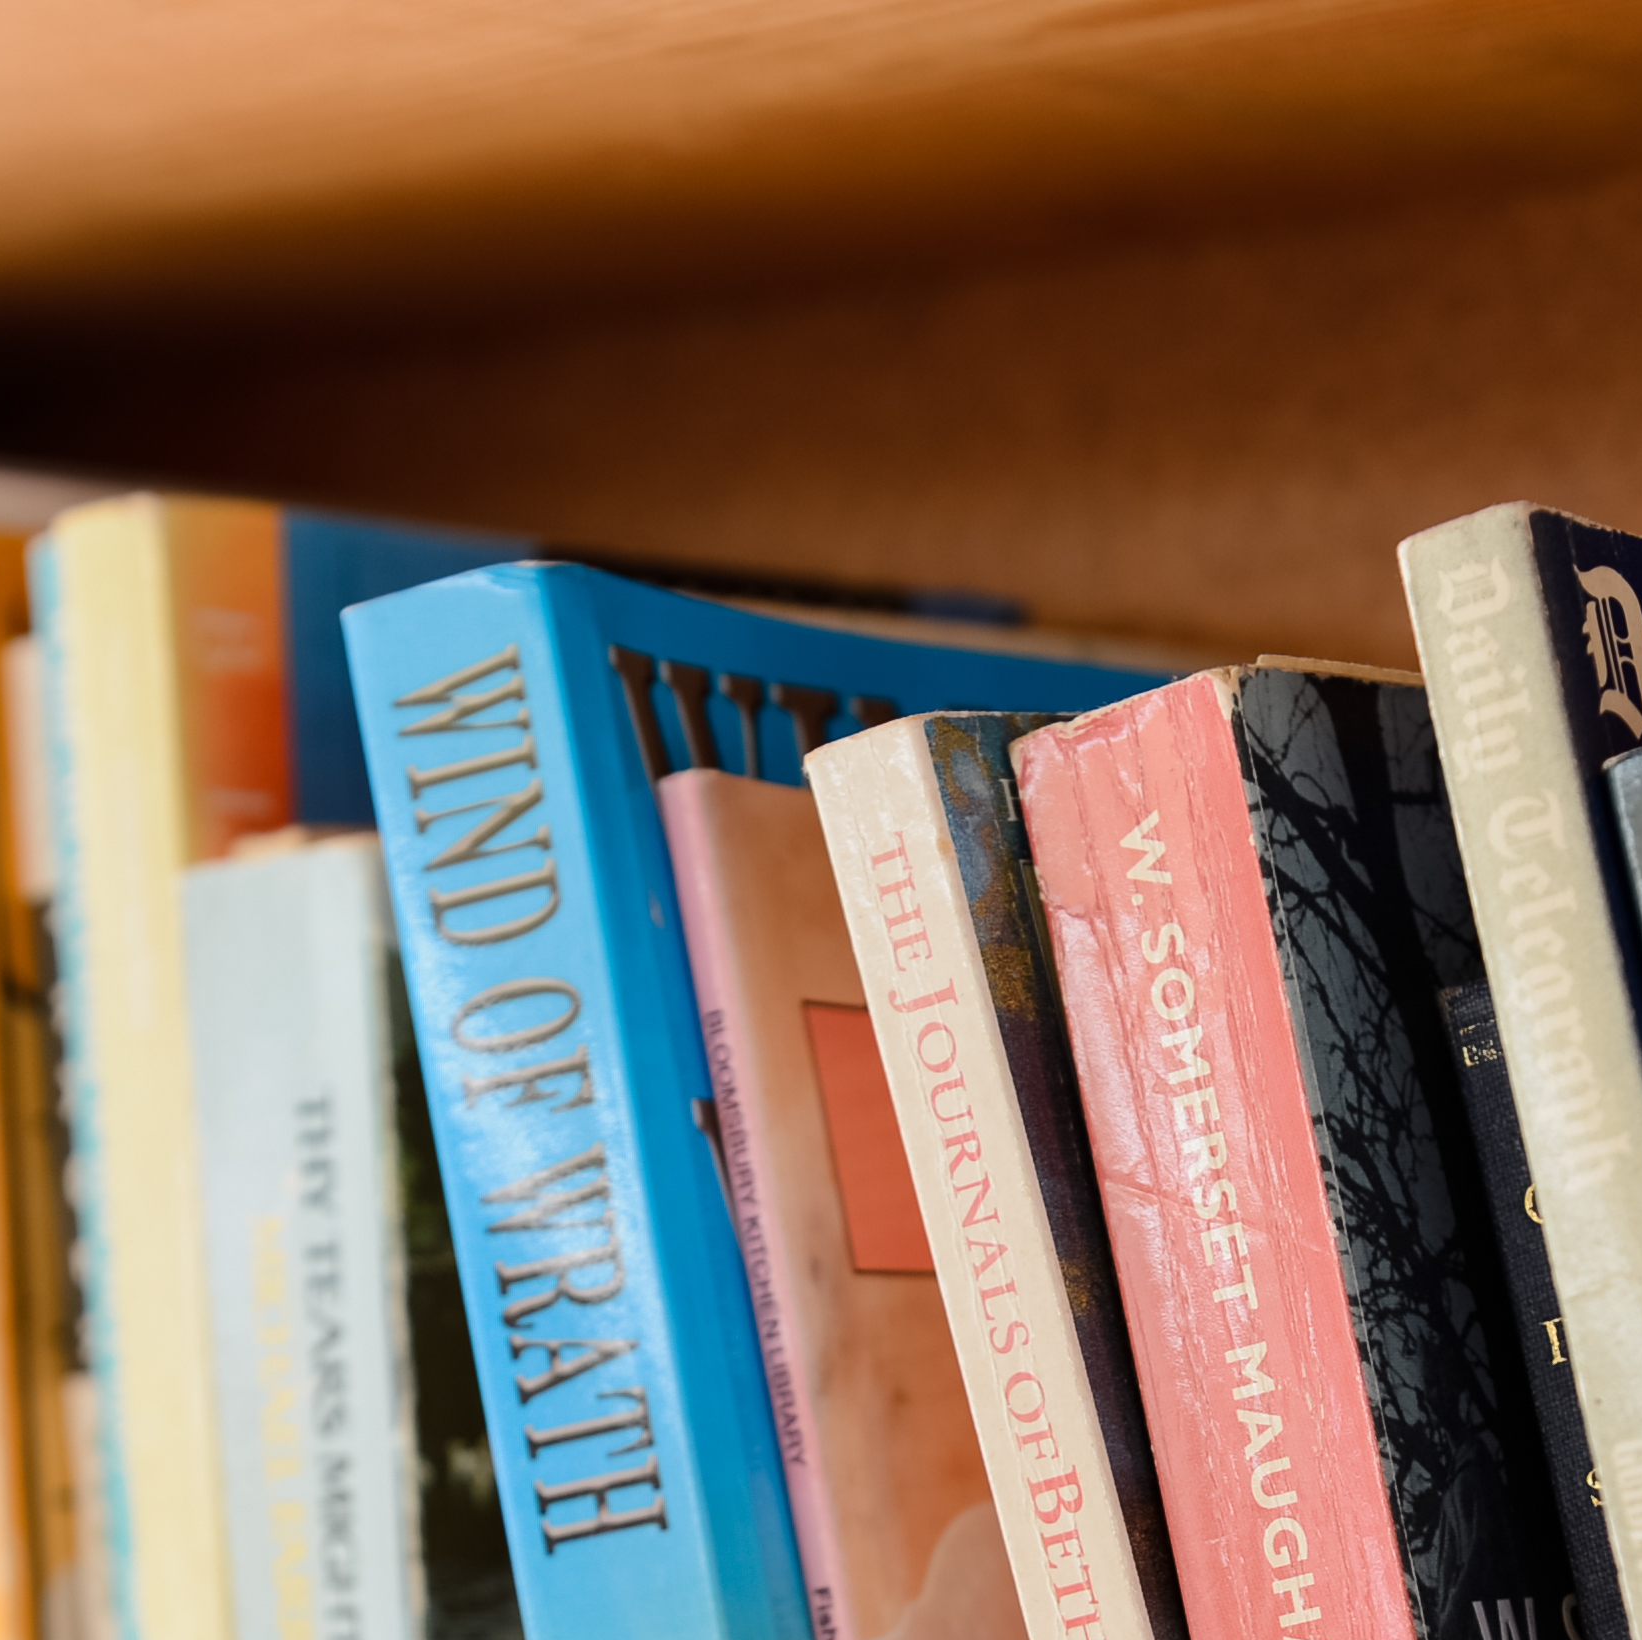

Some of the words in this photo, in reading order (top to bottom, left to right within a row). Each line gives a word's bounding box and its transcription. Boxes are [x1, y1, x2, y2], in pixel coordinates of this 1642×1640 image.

[393, 642, 561, 946] WIND
[869, 830, 932, 975] THE
[1437, 558, 1533, 782] Daily
[1488, 786, 1632, 1192] Telegraph
[295, 1095, 338, 1210] THY
[449, 975, 592, 1111] OF
[890, 980, 1031, 1357] JOURNALS
[1143, 920, 1260, 1310] SOMERSET
[303, 1238, 347, 1438] TEARS
[479, 1142, 668, 1555] WRATH
[704, 1010, 759, 1208] BLOOMSBURY
[741, 1215, 782, 1342] KITCHEN
[765, 1348, 807, 1469] LIBRARY
[1003, 1355, 1062, 1467] OF
